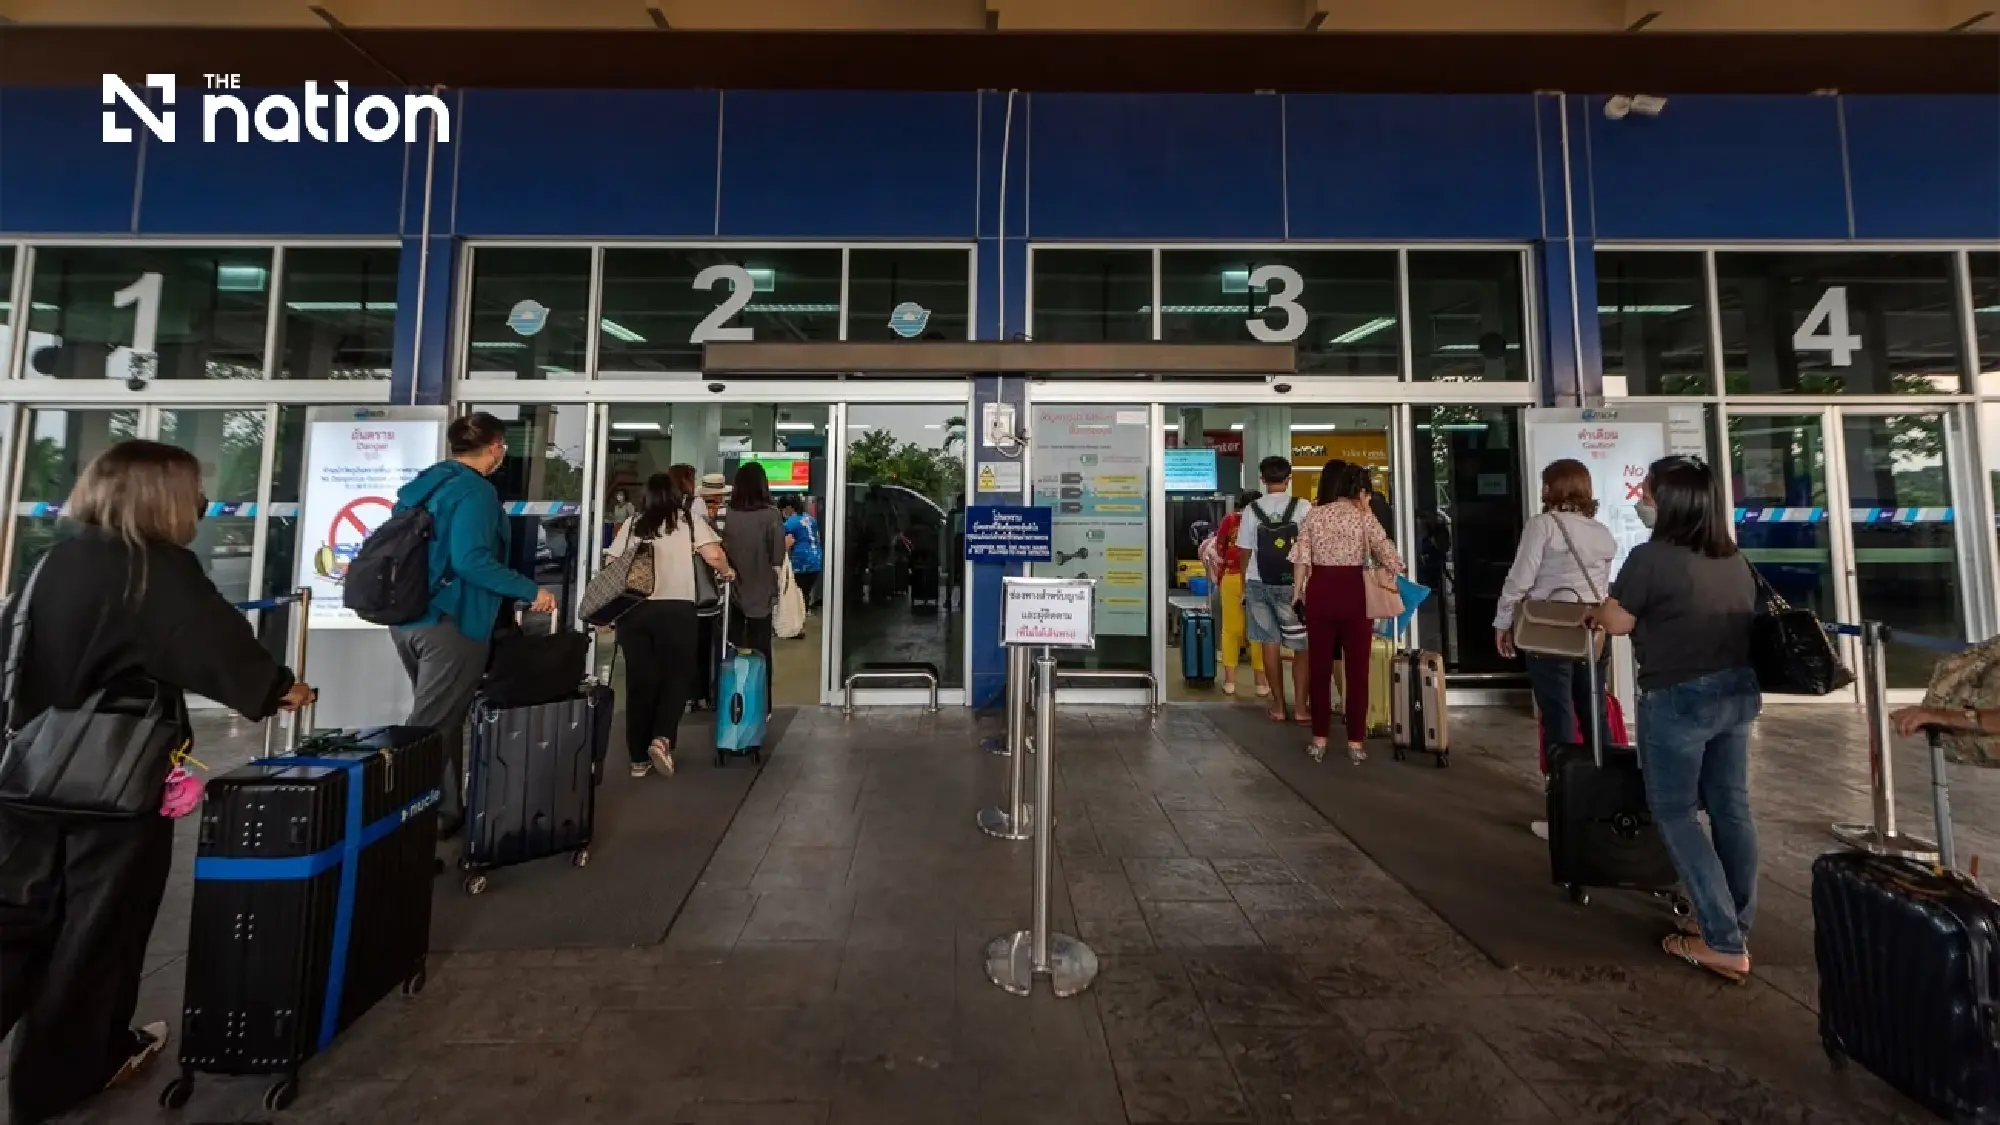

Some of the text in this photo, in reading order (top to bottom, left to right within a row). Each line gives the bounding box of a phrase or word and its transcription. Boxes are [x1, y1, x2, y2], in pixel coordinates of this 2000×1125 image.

[113, 271, 164, 353] 1
[688, 264, 755, 344] 2
[1245, 264, 1308, 343] 3
[1791, 285, 1863, 367] 4
[1577, 427, 1619, 441] คำเตือน
[1623, 464, 1645, 477] No
